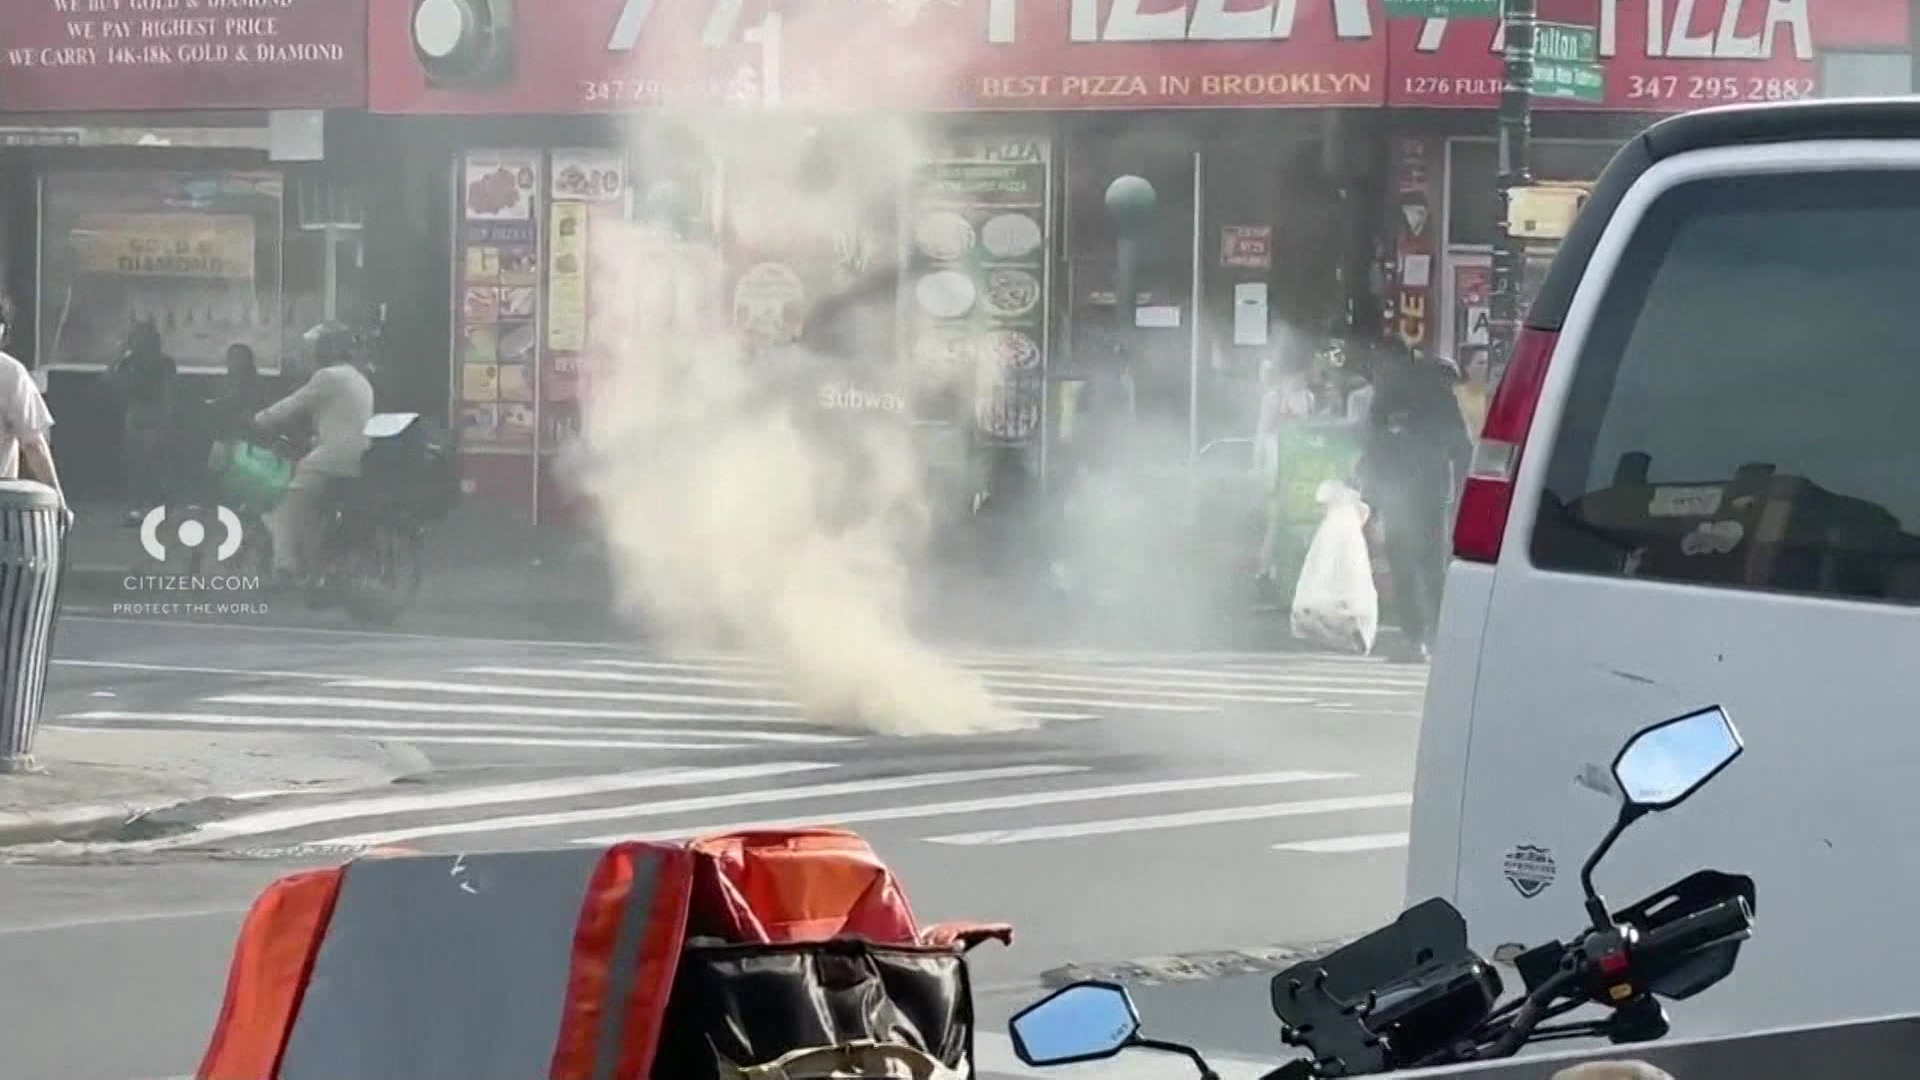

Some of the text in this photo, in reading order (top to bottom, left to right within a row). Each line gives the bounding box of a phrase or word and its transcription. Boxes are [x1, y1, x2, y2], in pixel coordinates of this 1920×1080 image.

[67, 17, 279, 39] WE PAY HIGHEST PRICE
[9, 43, 344, 66] WE CARRY 14K-18K GOLD & DIAMOND
[981, 73, 1371, 96] BEST PIZZA IN BROOKLYN
[1405, 77, 1450, 94] 1276
[1627, 75, 1678, 98] 347
[1473, 312, 1489, 335] A
[819, 385, 905, 413] Subway
